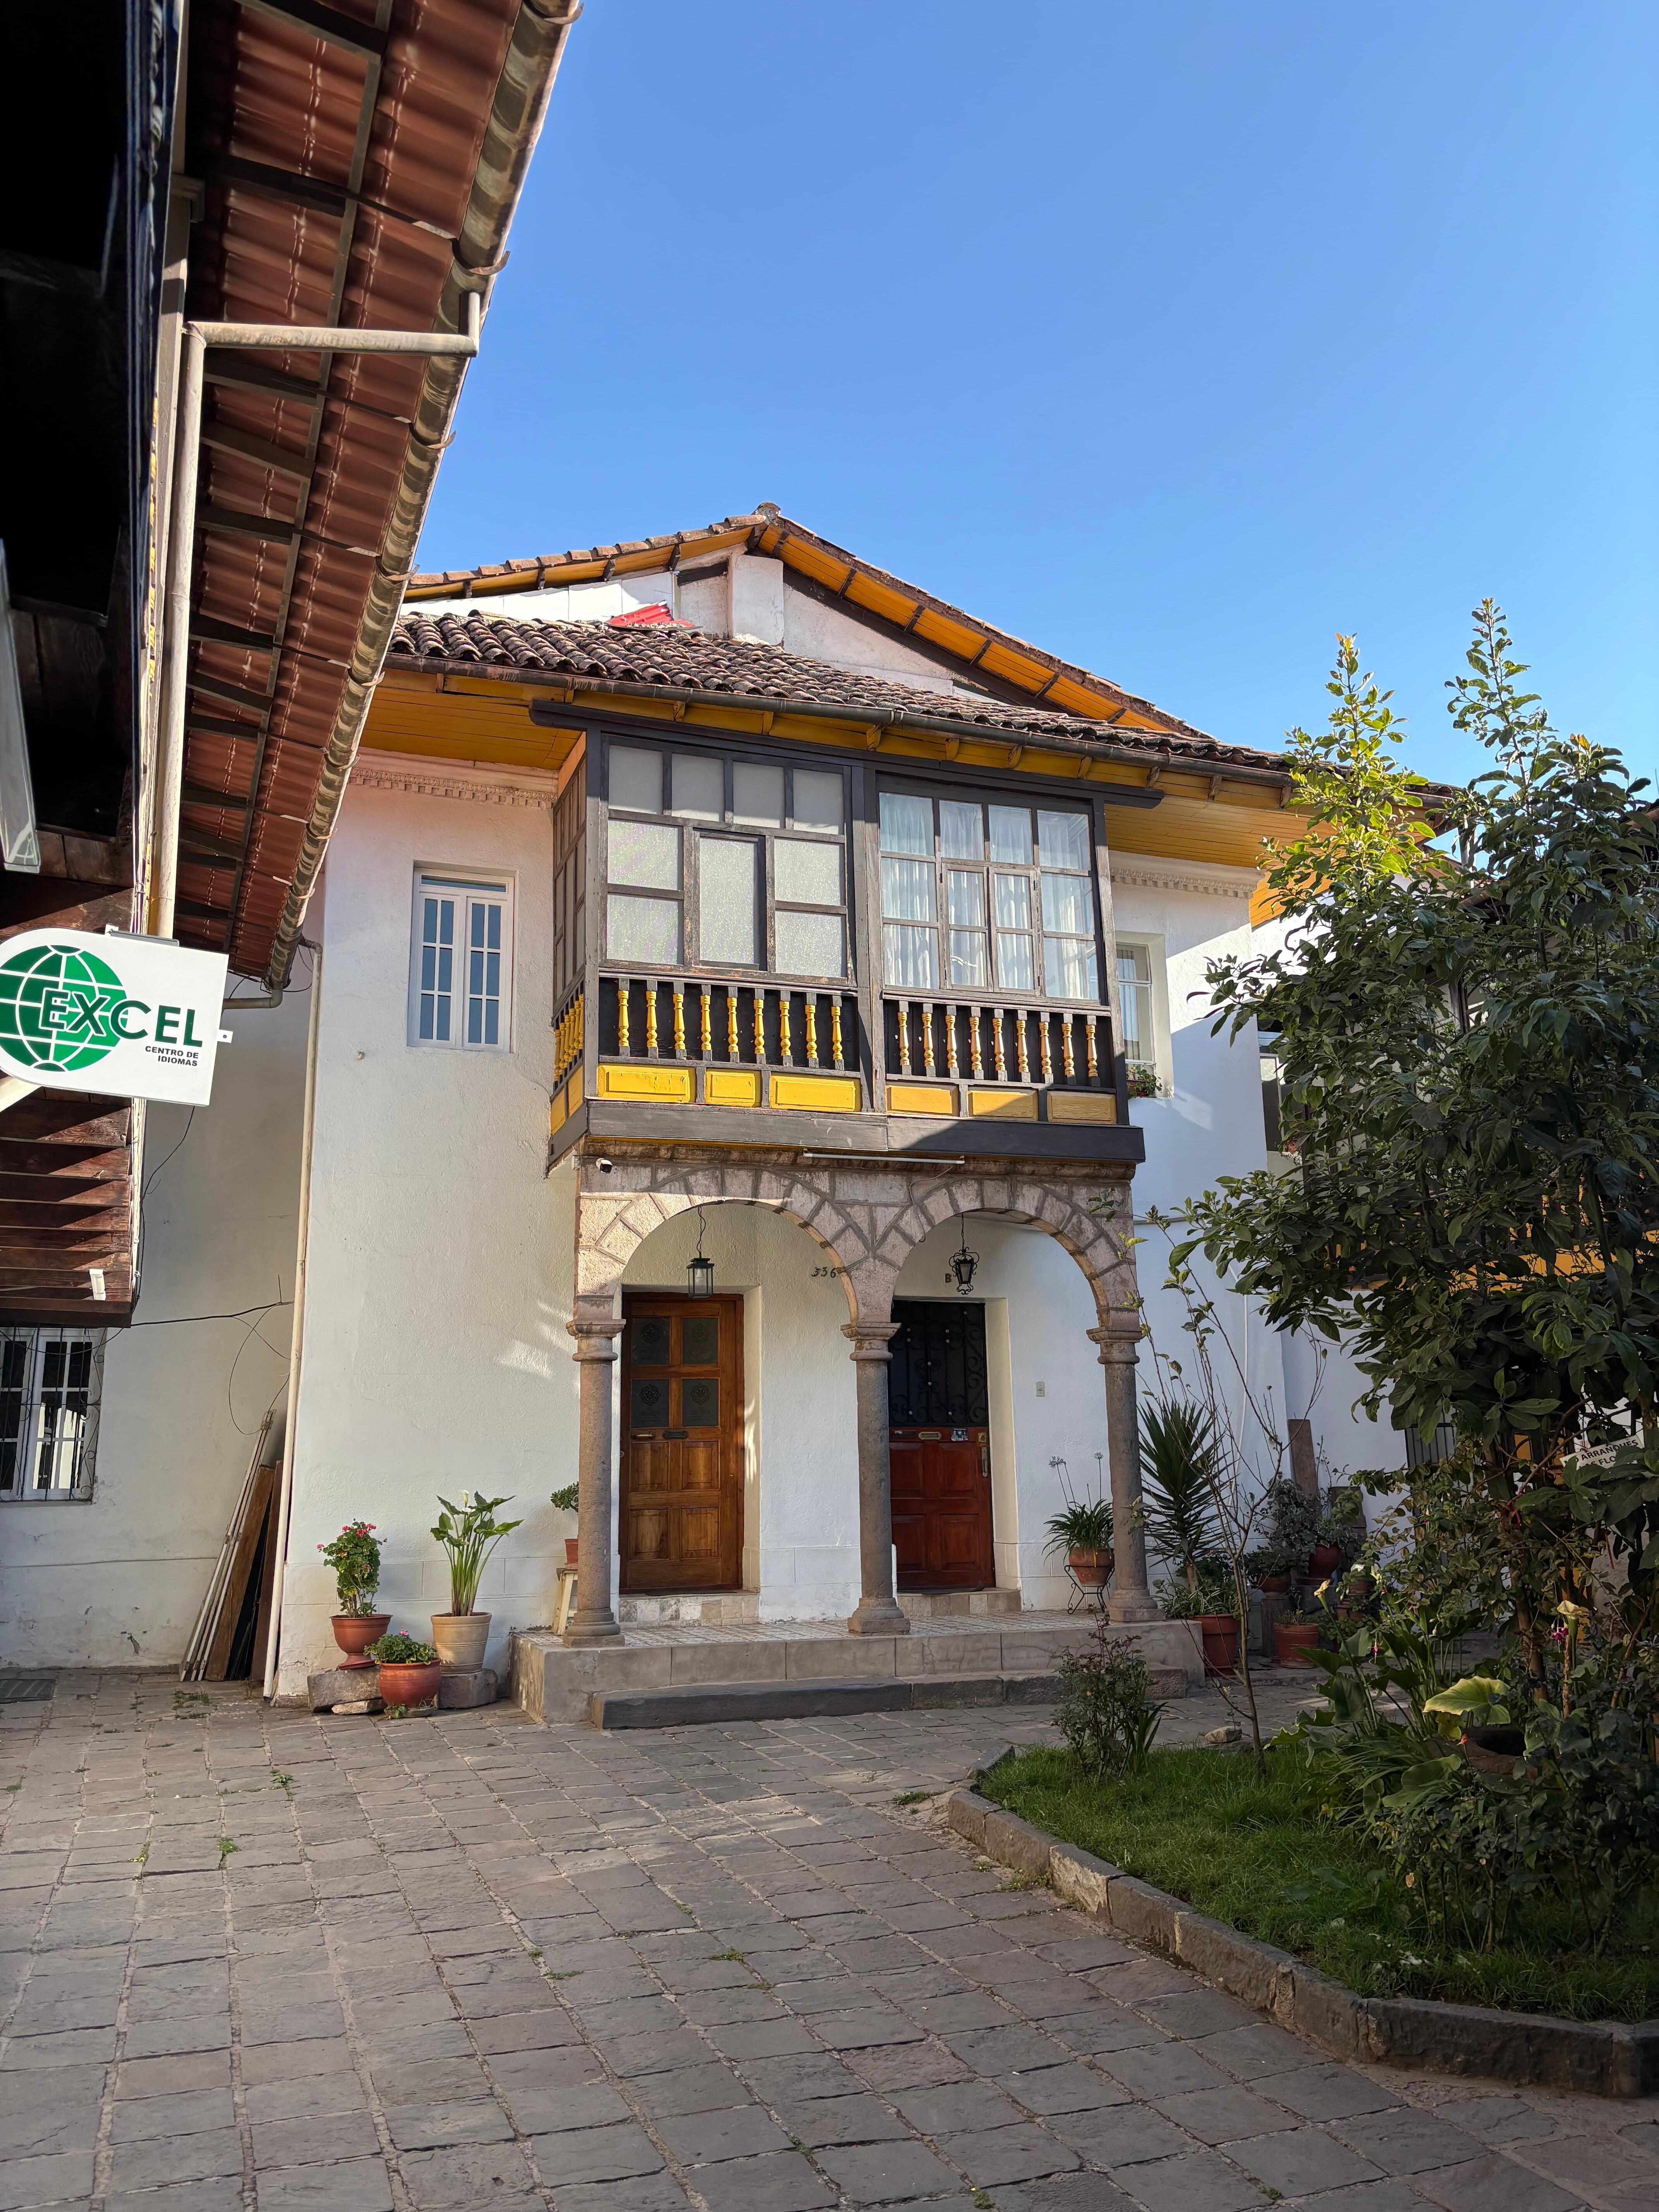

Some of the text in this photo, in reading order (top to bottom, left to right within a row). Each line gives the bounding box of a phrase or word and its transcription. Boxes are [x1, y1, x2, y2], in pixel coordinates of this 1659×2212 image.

[41, 989, 203, 1047] EXCEL
[145, 1046, 184, 1056] CENTRO
[158, 1055, 198, 1066] IDIOMAS
[945, 1273, 951, 1283] B
[1598, 1456, 1616, 1465] FLO
